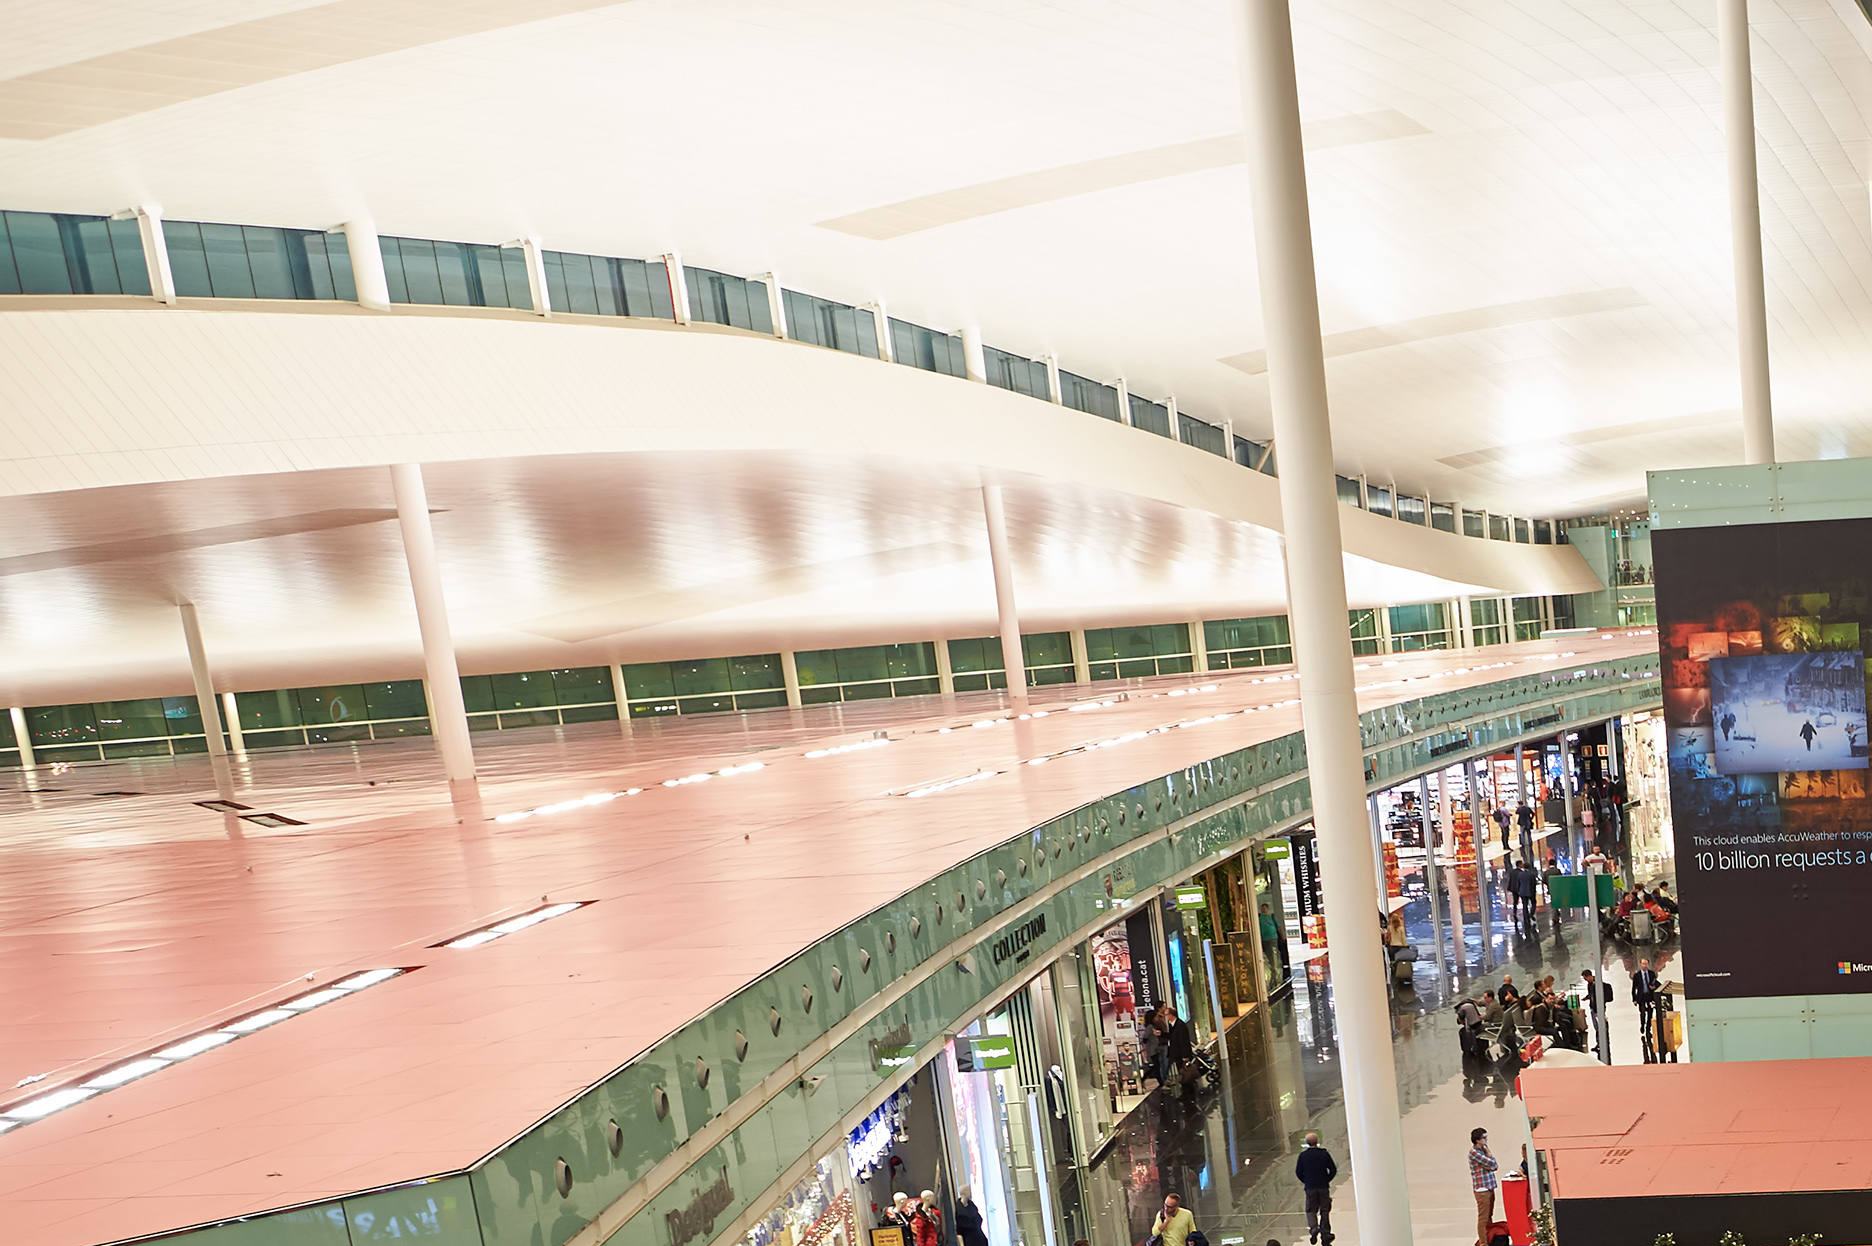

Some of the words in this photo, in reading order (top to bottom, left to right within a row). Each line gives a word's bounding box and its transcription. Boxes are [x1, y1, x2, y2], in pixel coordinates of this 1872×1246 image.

[1693, 836, 1712, 847] This
[1713, 834, 1739, 846] cloud
[1740, 833, 1776, 845] enables
[1777, 831, 1839, 843] AccuWeather
[1840, 831, 1851, 841] to
[1299, 845, 1309, 892] WHISKIES
[1694, 852, 1714, 871] 10
[1718, 850, 1771, 871] billion
[1775, 848, 1852, 872] requests
[1855, 852, 1866, 865] a
[993, 913, 1047, 966] COLLECTION
